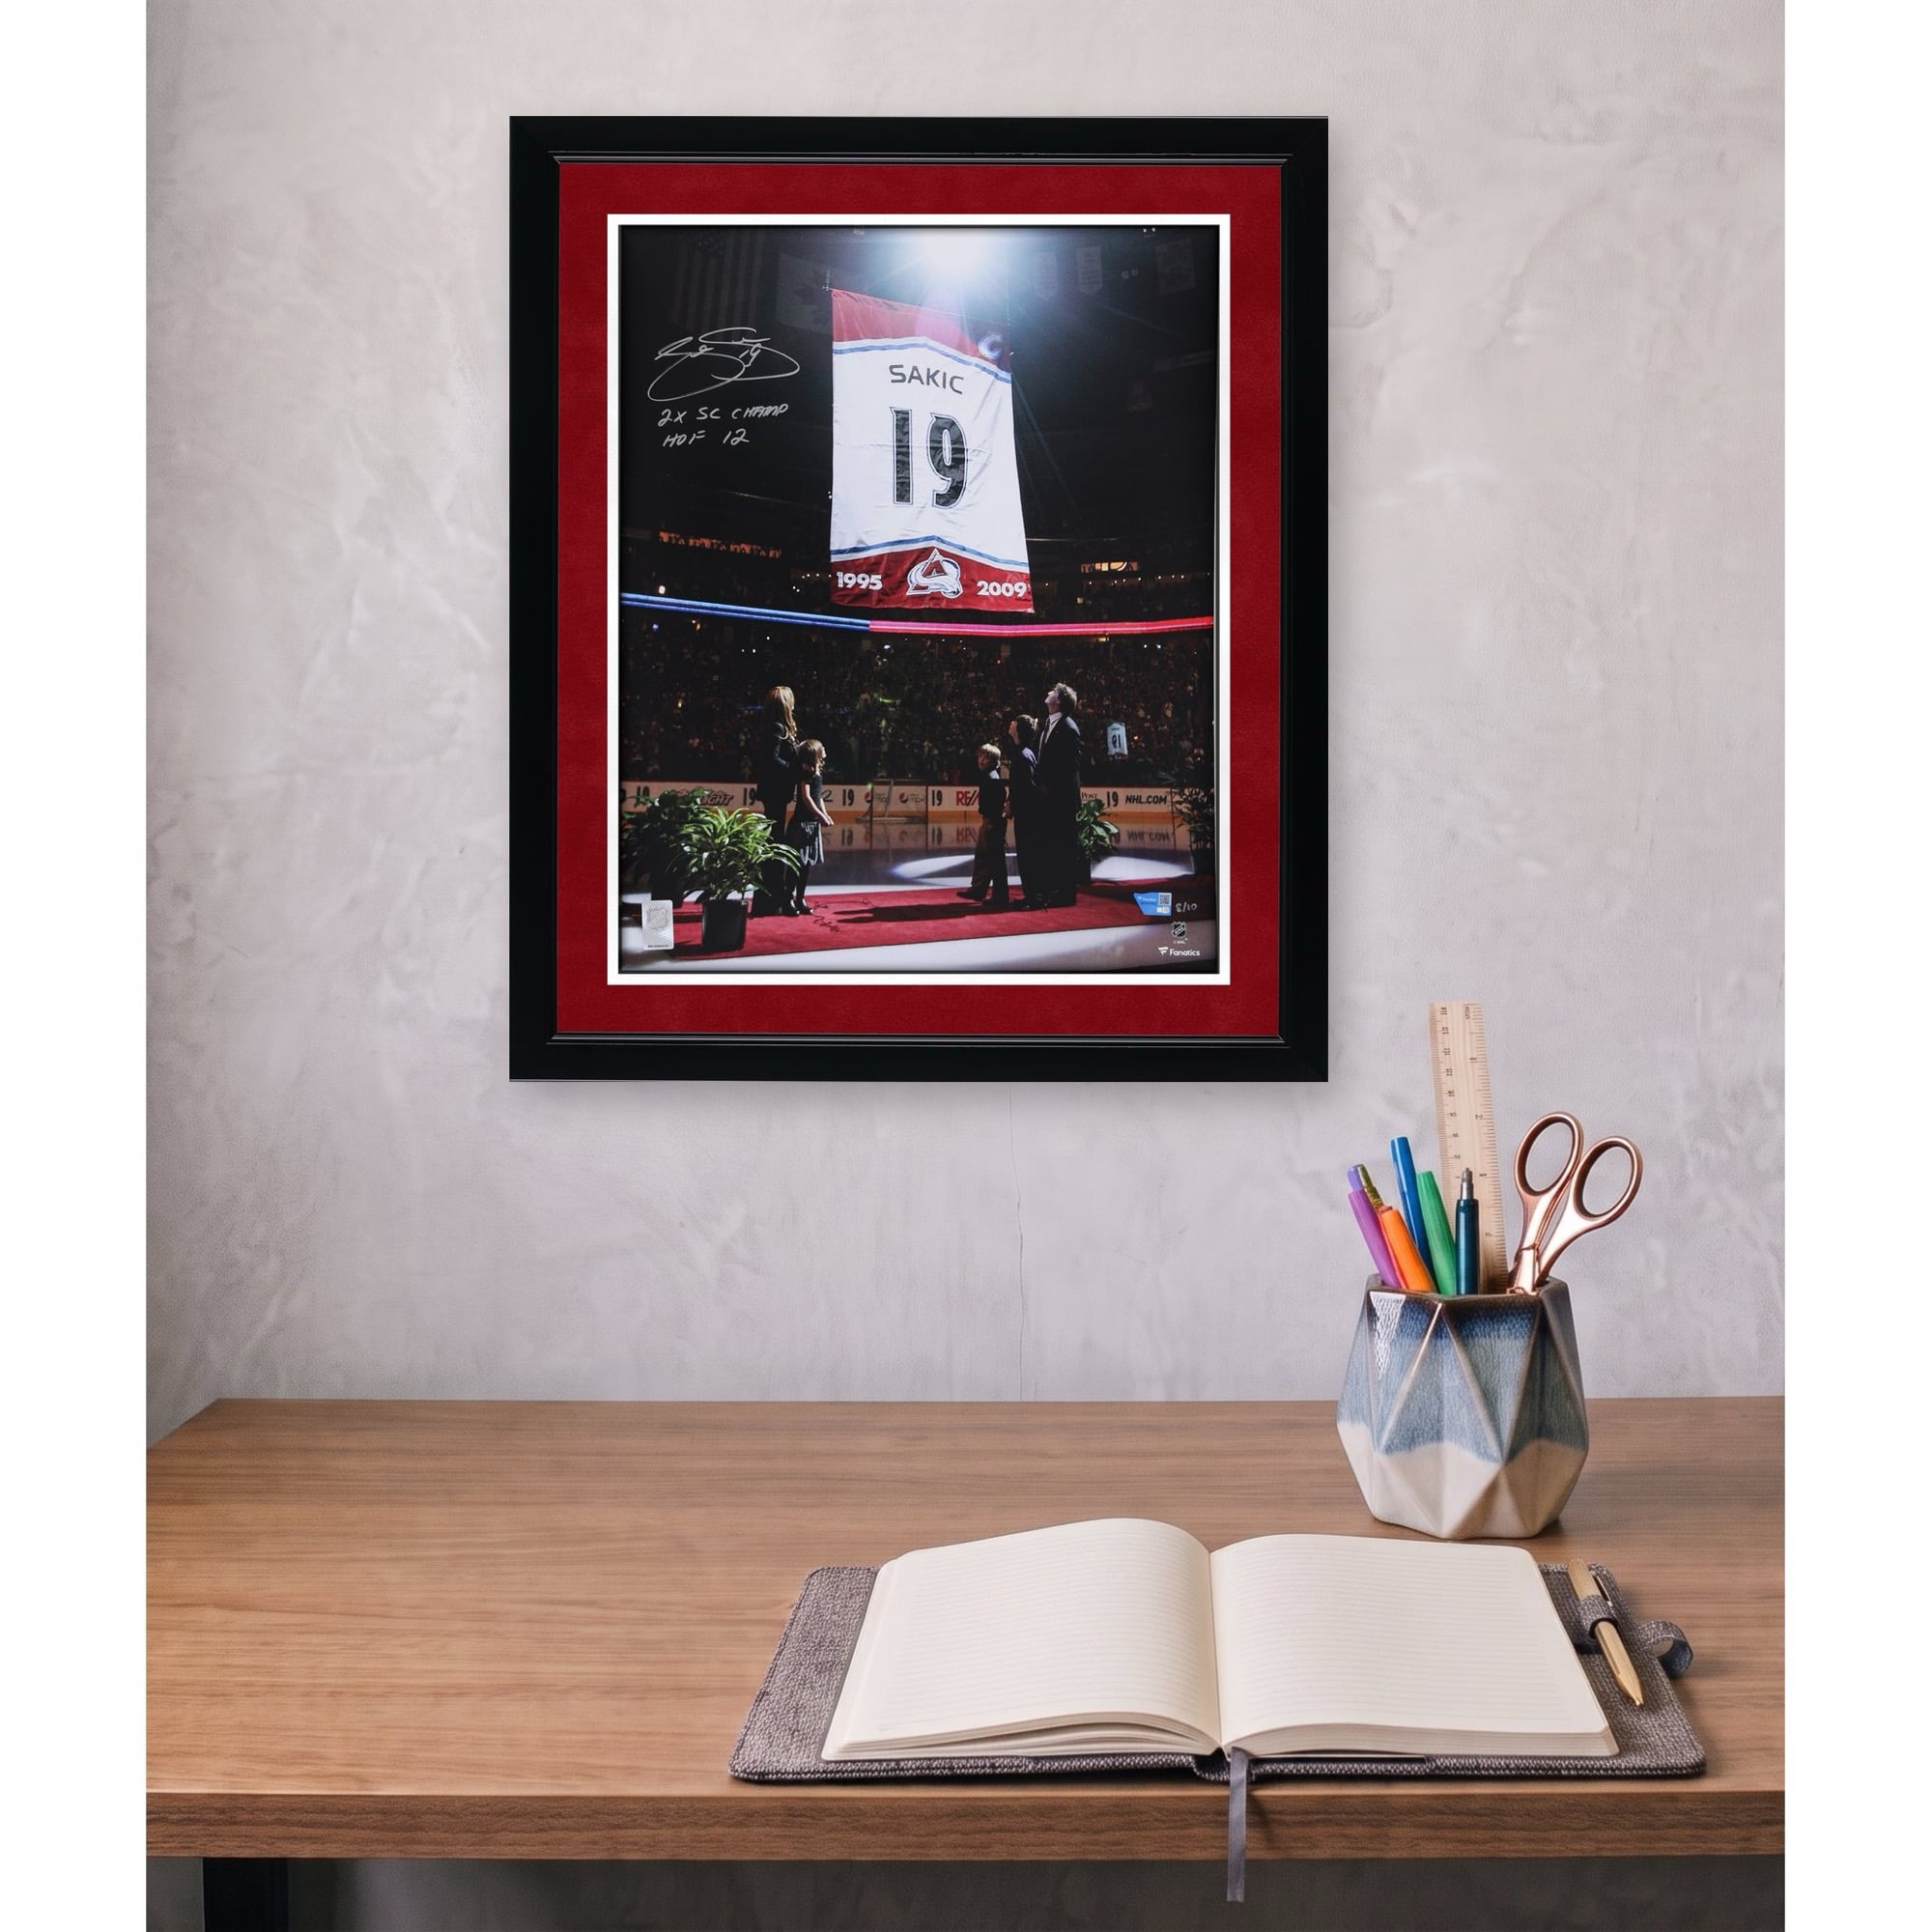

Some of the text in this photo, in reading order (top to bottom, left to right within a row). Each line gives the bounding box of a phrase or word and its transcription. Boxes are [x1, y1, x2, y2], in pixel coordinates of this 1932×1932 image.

[888, 363, 965, 395] SAKIC
[695, 406, 723, 421] SC
[731, 403, 789, 420] CHAMP
[662, 428, 751, 447] HOF 12
[889, 407, 969, 509] 19
[837, 571, 1028, 598] 1995 2009
[842, 789, 855, 806] 19
[931, 790, 943, 807] 19
[1106, 790, 1119, 808] 19
[1124, 795, 1167, 805] NHL.COM
